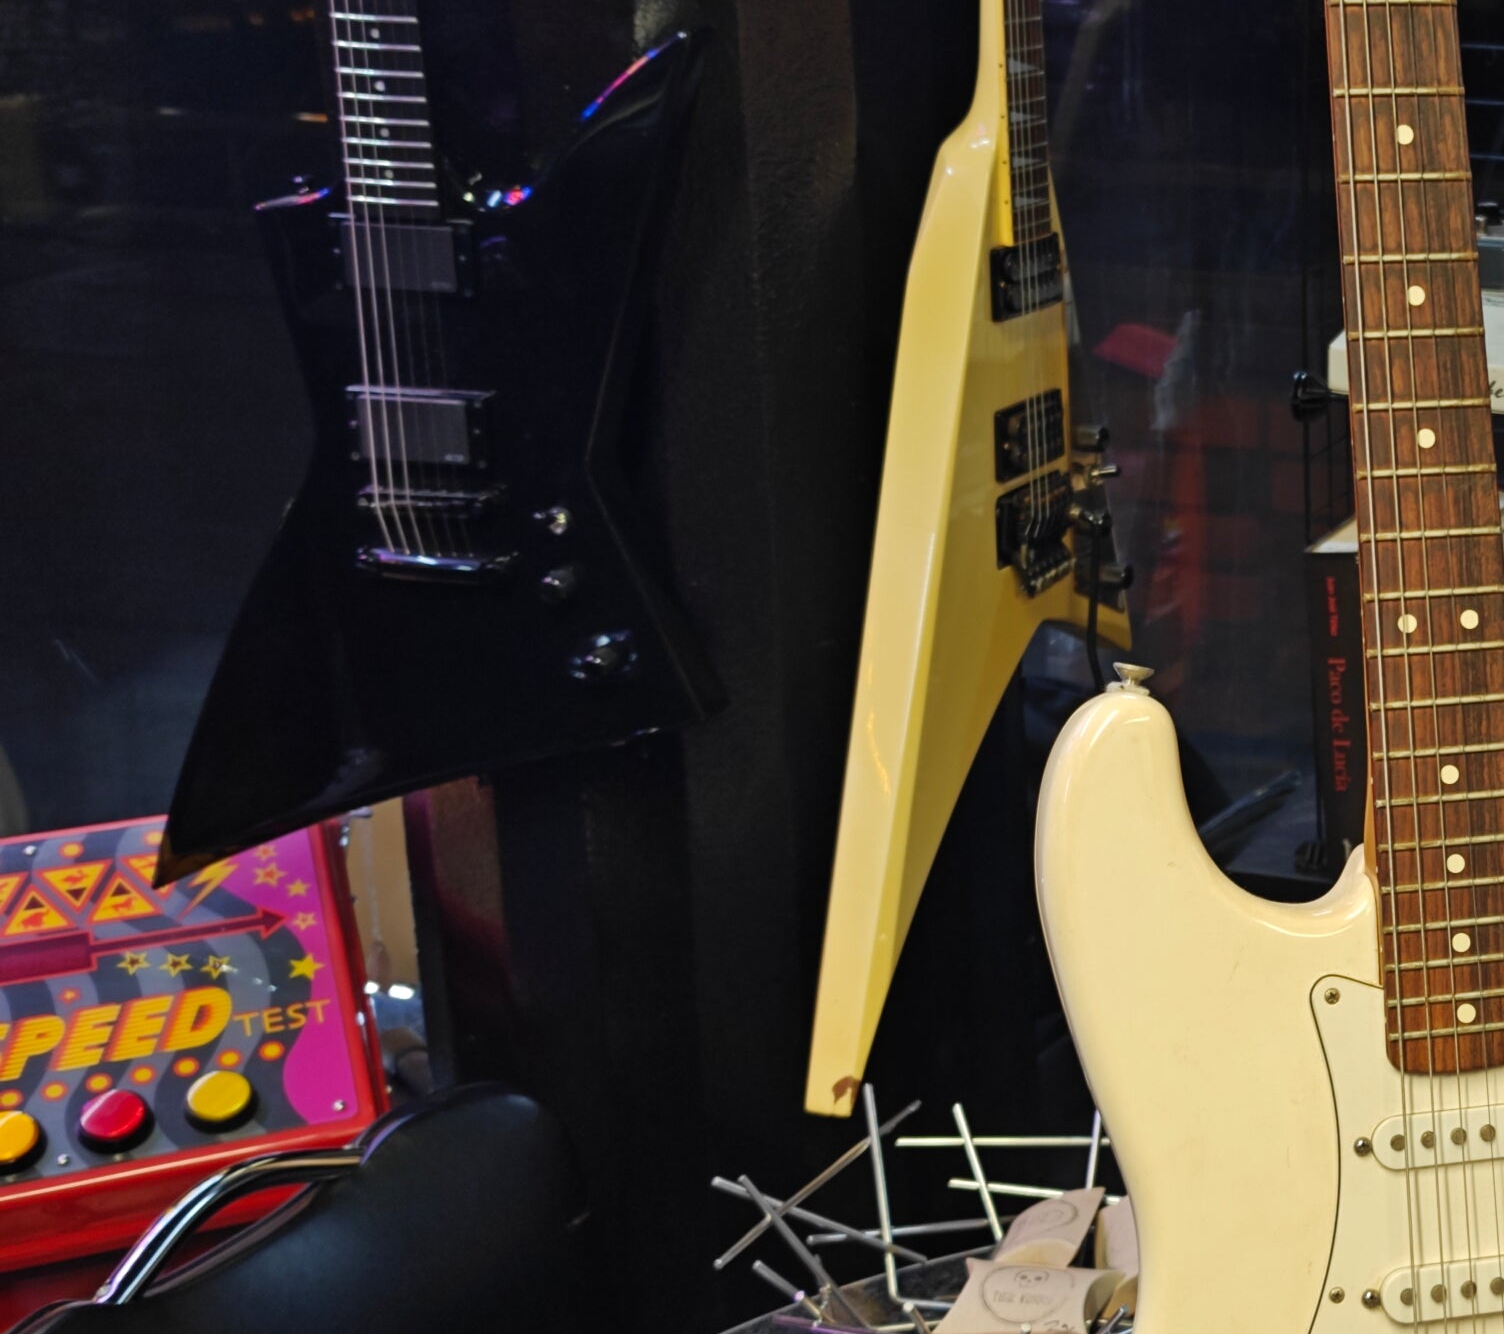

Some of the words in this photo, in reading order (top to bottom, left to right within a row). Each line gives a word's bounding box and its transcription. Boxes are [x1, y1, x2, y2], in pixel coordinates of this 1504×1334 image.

[1326, 656, 1348, 706] Paco
[1331, 709, 1350, 734] de
[0, 986, 232, 1082] PEED
[233, 998, 331, 1037] TEST
